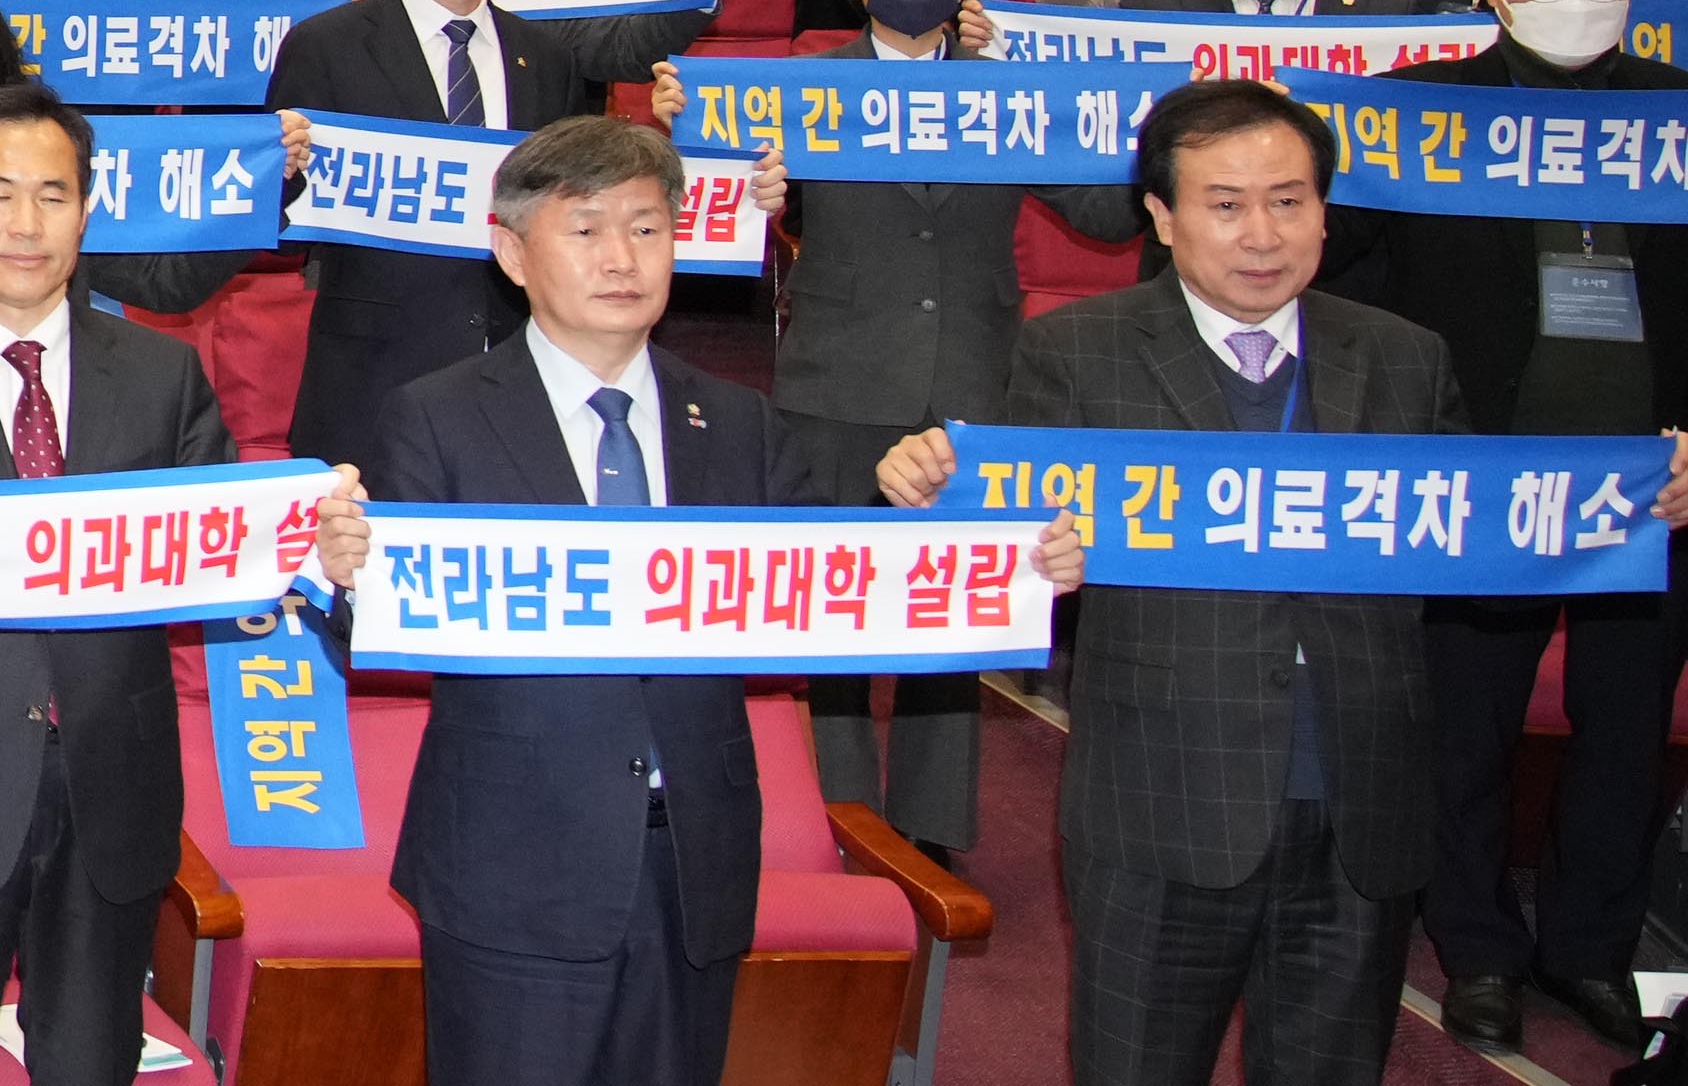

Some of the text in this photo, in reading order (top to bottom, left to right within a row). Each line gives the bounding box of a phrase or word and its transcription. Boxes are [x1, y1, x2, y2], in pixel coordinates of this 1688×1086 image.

[62, 13, 229, 77] 의료격차
[698, 85, 1050, 155] 지역 간 의료격차
[1419, 110, 1467, 182] 간
[161, 147, 254, 219] 해소
[305, 150, 467, 224] 전라남도
[1122, 465, 1633, 556] 간 의료격차 해소
[26, 509, 248, 595] 의과대학
[388, 547, 611, 630] 전라남도
[646, 546, 876, 632] 의과대학
[908, 544, 1019, 629] 설립
[246, 720, 321, 815] 지역
